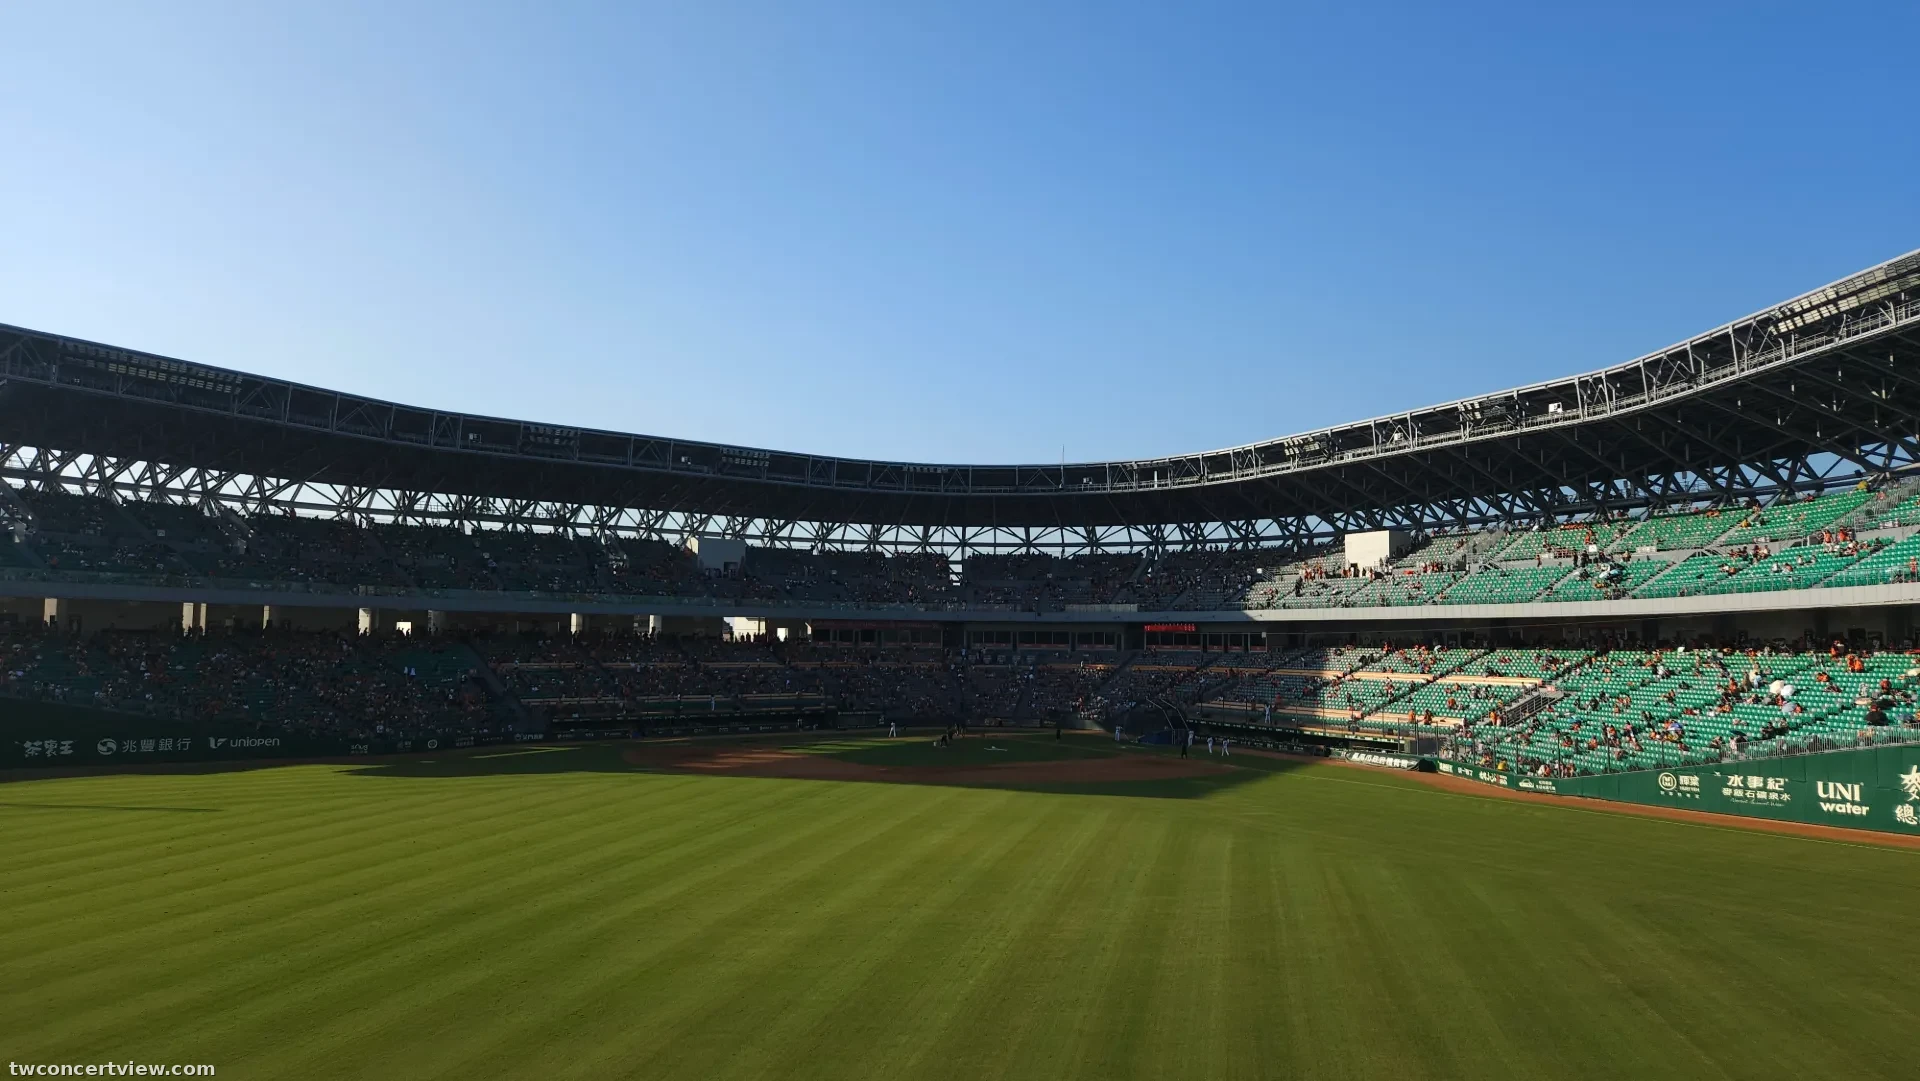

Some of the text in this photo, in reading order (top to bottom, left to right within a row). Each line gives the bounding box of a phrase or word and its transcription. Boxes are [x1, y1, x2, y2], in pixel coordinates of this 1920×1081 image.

[121, 737, 192, 752] 兆豐銀行
[230, 736, 280, 748] uniopen
[1726, 775, 1785, 791] 水事紀
[1816, 781, 1861, 801] UNI
[1819, 802, 1869, 816] water
[1895, 803, 1920, 825] 總
